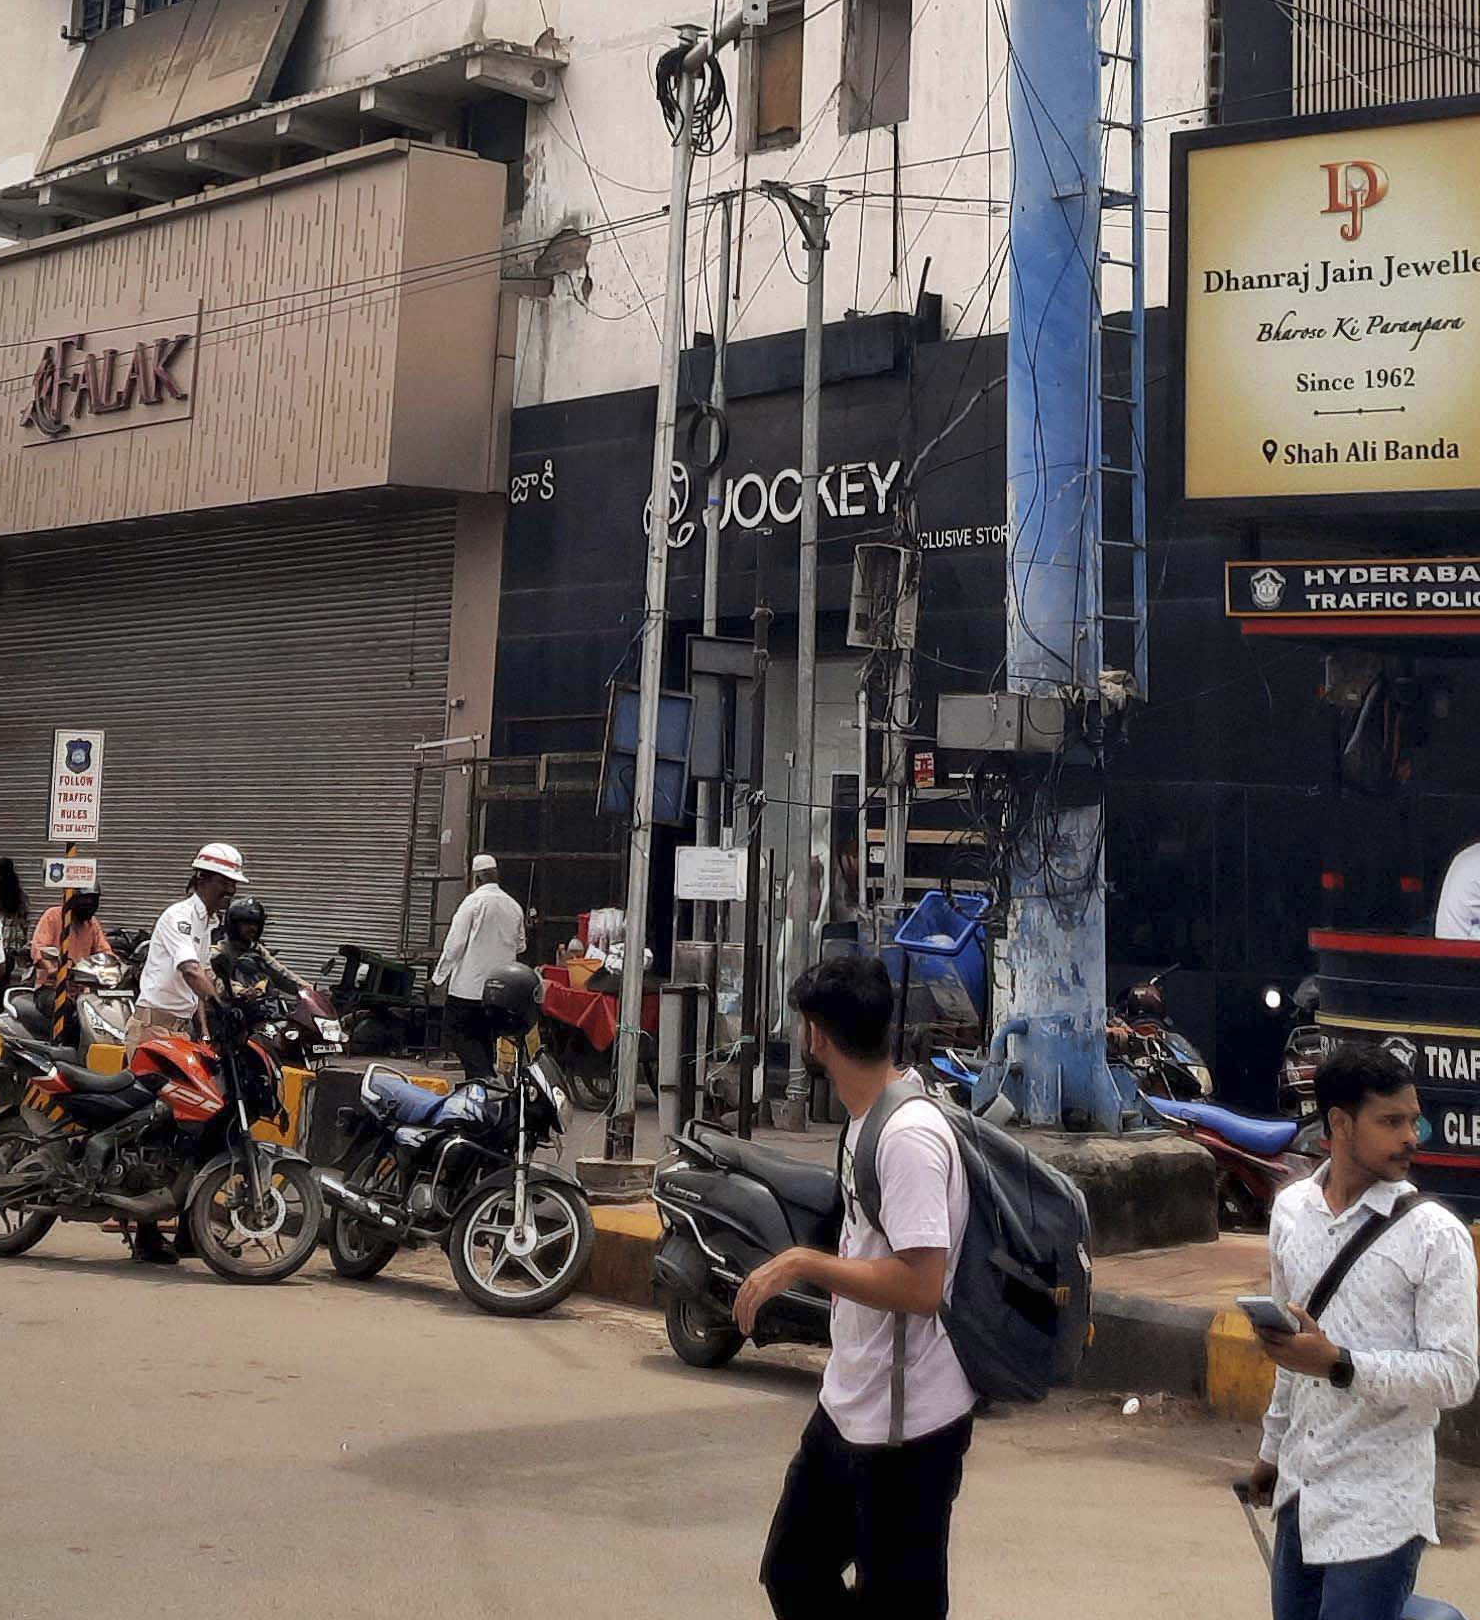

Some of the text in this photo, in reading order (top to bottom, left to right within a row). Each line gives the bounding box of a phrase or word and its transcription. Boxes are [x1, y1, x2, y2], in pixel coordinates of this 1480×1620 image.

[1202, 262, 1310, 295] Dhanraj
[1316, 256, 1376, 293] Jain
[1255, 309, 1467, 350] Bharose Ki Parampara
[1296, 367, 1416, 393] Since 1962
[1283, 438, 1460, 466] Shah Ali Banda
[702, 460, 901, 531] JOCKEY
[917, 529, 972, 550] CLUSIVE
[1306, 590, 1408, 610] TRAFFIC
[59, 775, 94, 787] FOLLOW
[57, 792, 93, 804] TRAFFIC
[60, 809, 88, 820] RULES
